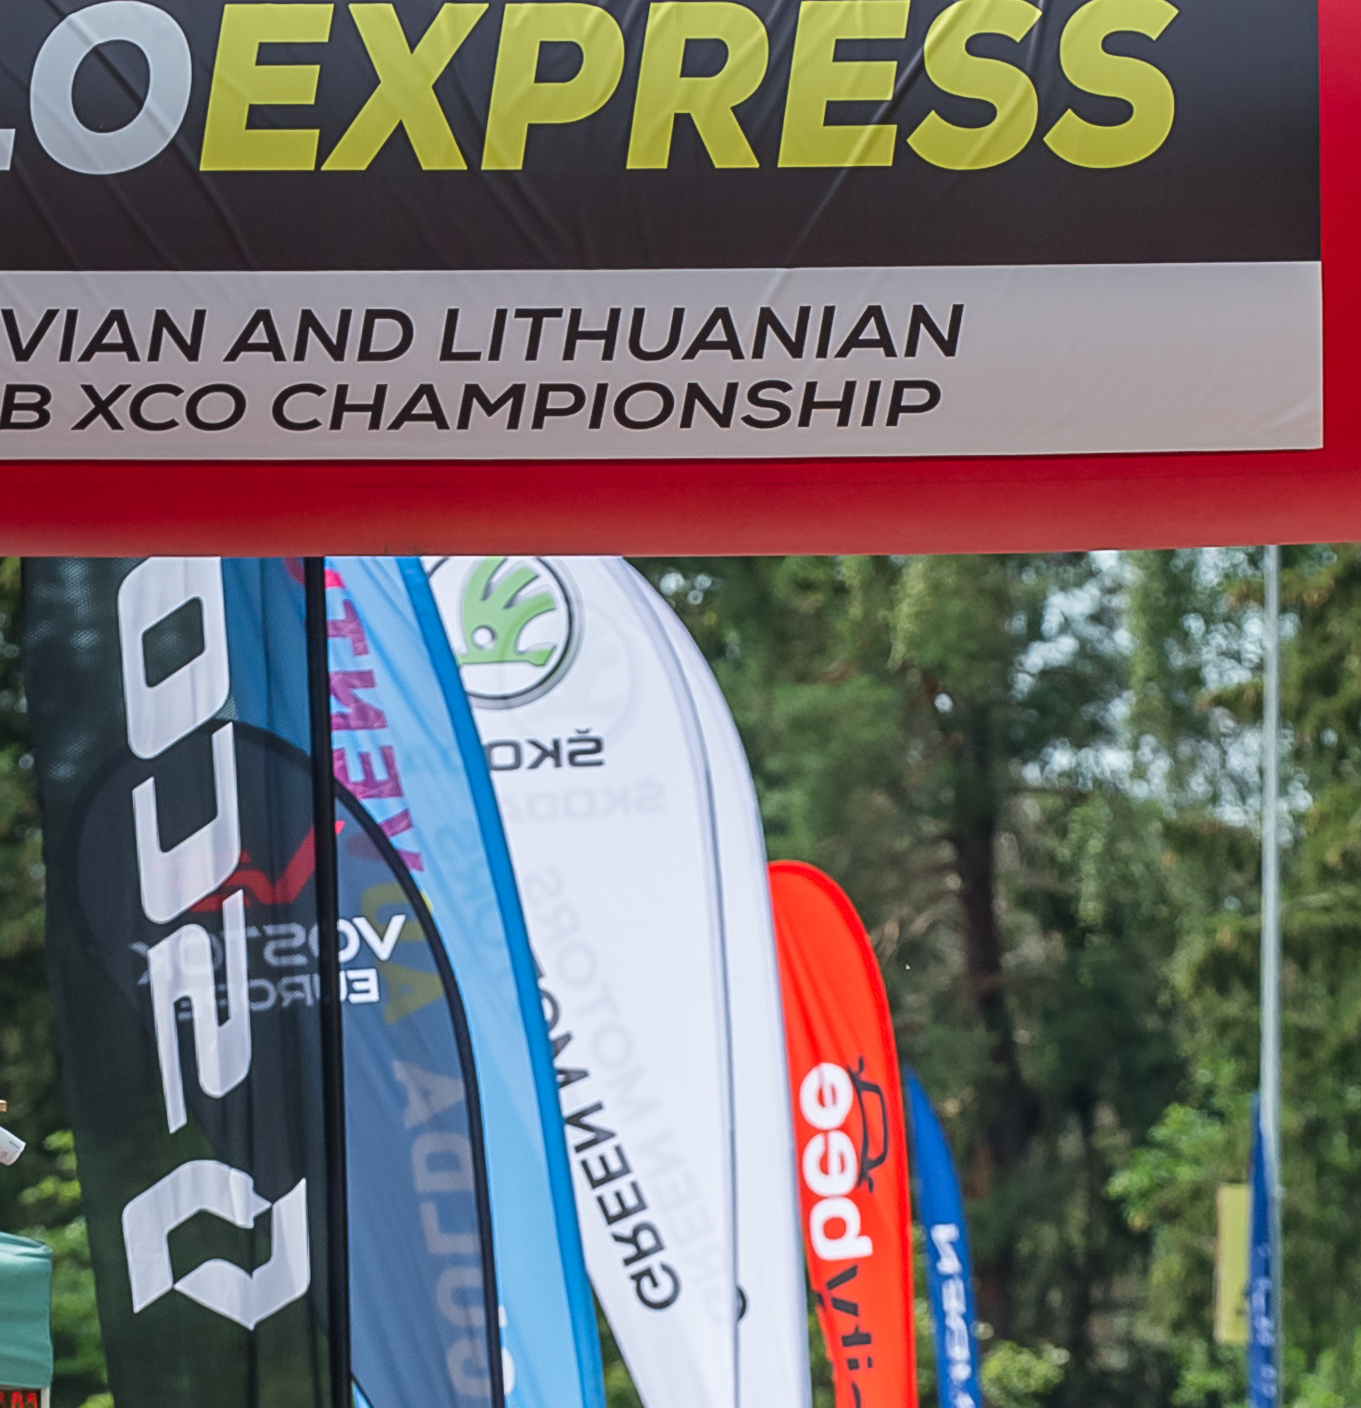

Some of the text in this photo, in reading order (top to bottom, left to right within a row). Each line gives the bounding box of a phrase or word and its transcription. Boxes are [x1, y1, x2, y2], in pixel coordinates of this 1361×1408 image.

[228, 307, 414, 362] AND
[439, 303, 964, 362] LITHUANIAN
[73, 381, 248, 431] XCO
[270, 378, 941, 431] CHAMPIONSHIP
